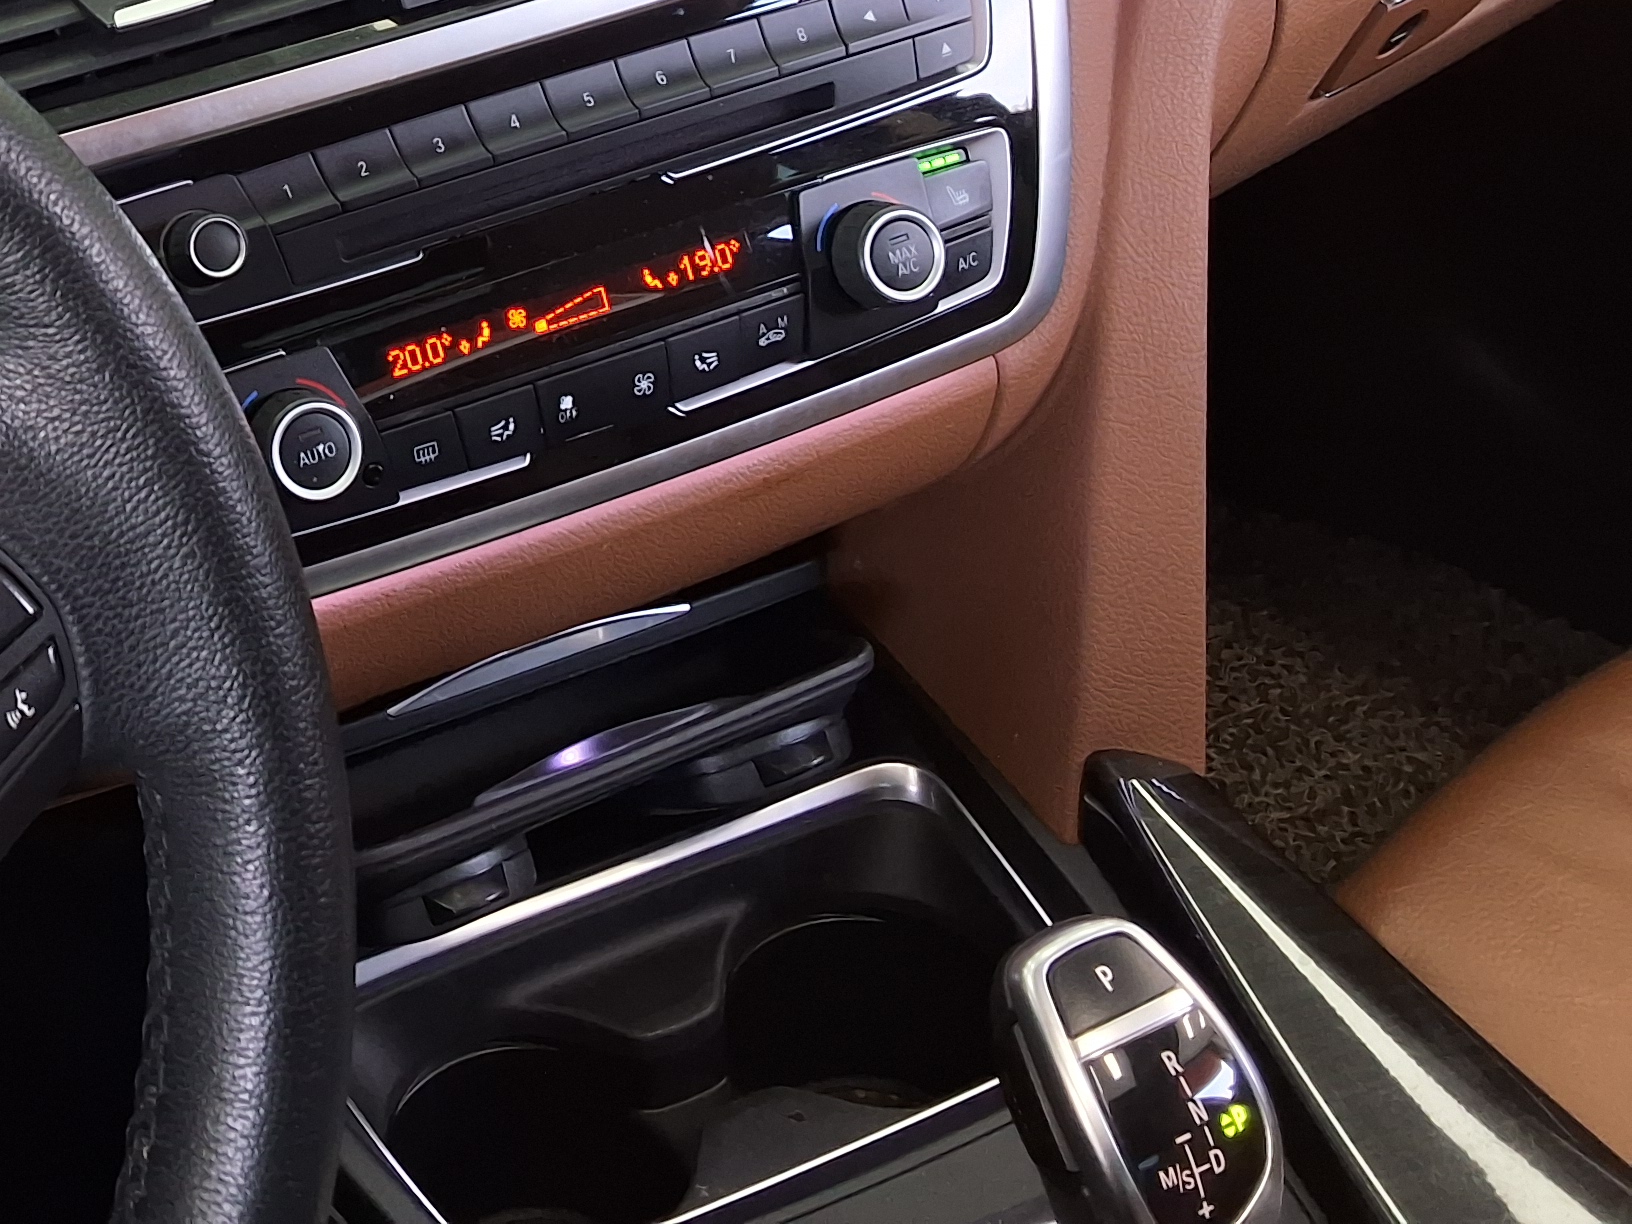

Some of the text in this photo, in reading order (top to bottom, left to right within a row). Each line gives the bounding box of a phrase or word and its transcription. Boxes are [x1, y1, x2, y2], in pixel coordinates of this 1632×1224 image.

[796, 26, 807, 42] 8
[726, 48, 737, 65] 7
[655, 70, 667, 85] 6
[582, 92, 595, 108] 5
[508, 113, 521, 130] 4
[432, 137, 446, 154] 3
[357, 160, 369, 177] 2
[282, 183, 293, 200] 1
[889, 243, 918, 265] MAX
[958, 251, 979, 273] A/C
[898, 258, 920, 278] A/C
[758, 323, 768, 336] A
[777, 315, 789, 327] M
[299, 441, 336, 468] AUTO
[1094, 964, 1114, 993] P
[1160, 1050, 1183, 1076] R
[1187, 1098, 1209, 1126] N
[1208, 1149, 1225, 1175] D
